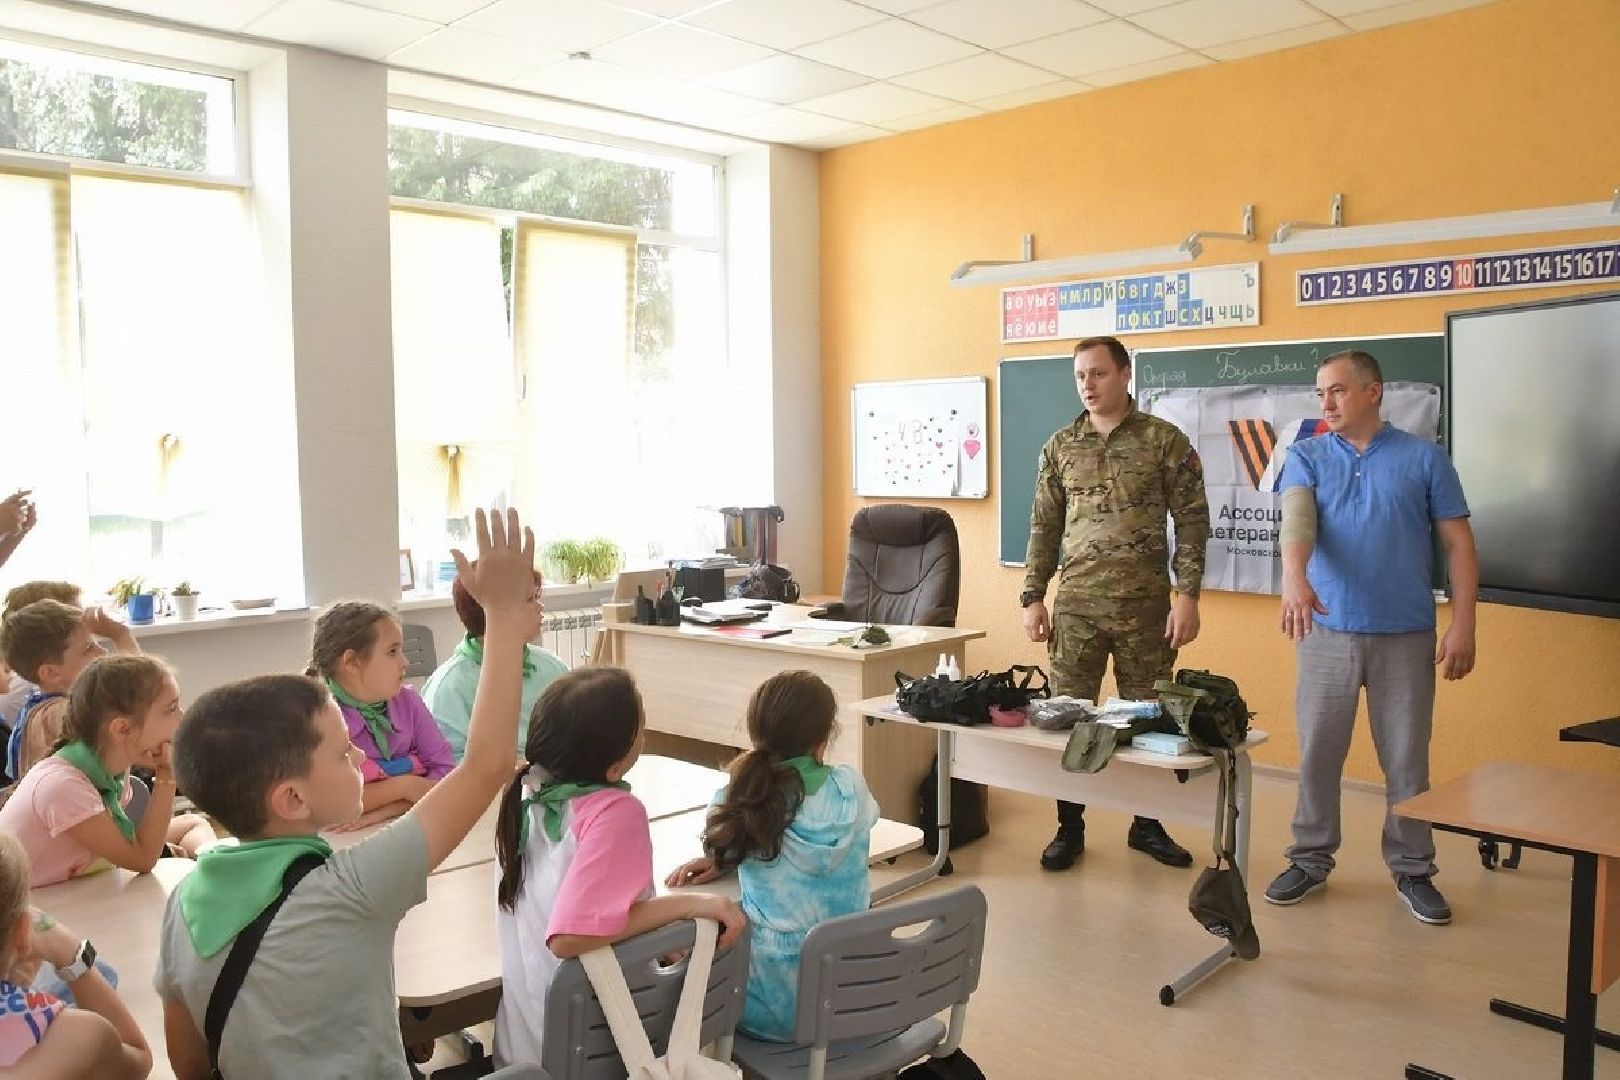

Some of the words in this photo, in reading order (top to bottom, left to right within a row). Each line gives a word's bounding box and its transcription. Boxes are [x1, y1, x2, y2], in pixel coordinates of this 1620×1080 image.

[1301, 278, 1312, 299] 0
[1317, 277, 1325, 298] 1
[1331, 275, 1341, 296] 2
[1346, 273, 1357, 295] 3
[1361, 271, 1372, 293] 4
[1377, 271, 1387, 292] 5
[1392, 269, 1403, 291] 6
[1408, 267, 1418, 290] 7
[1424, 266, 1436, 288] 8
[1440, 265, 1452, 287] 9
[1455, 263, 1472, 285] 10
[1476, 261, 1491, 284] 11
[1493, 259, 1511, 283] 12
[1514, 258, 1531, 281] 13
[1533, 256, 1551, 280] 14
[1554, 254, 1572, 279] 15
[1575, 252, 1594, 276] 16
[1596, 251, 1615, 275] 17
